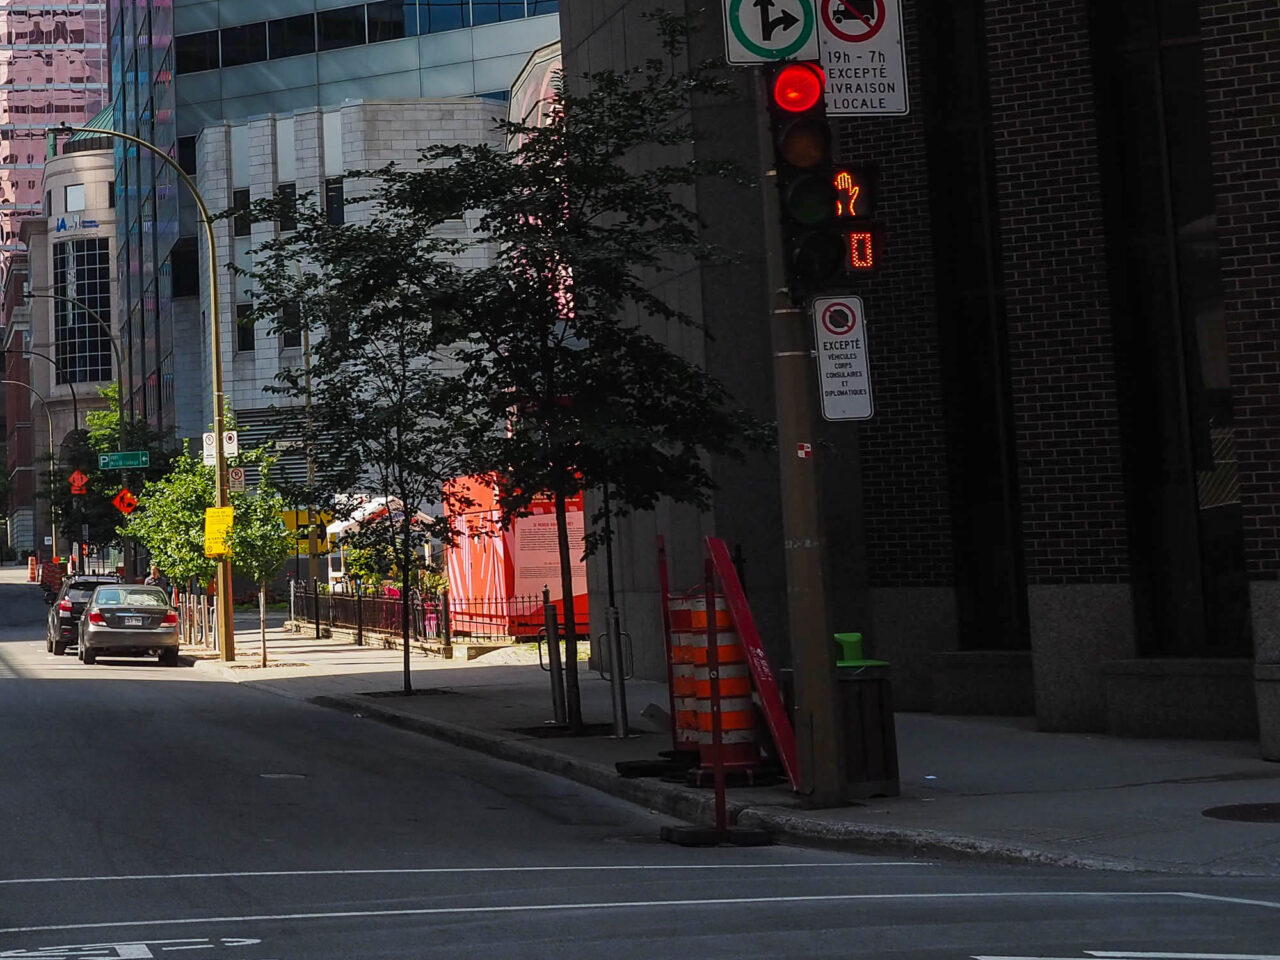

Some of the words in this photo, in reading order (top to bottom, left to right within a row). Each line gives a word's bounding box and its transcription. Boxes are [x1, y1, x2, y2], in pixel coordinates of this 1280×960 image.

[828, 51, 850, 63] 19h
[869, 50, 886, 63] 7h
[829, 64, 887, 79] EXCEPTÉ
[824, 82, 895, 94] IVRAISON
[834, 98, 887, 109] LOCALE
[851, 232, 872, 268] 0
[823, 339, 861, 351] EXCEPTÉ
[828, 353, 857, 361] VÉHICULES
[826, 371, 862, 379] CONSULAIRES
[824, 389, 867, 397] DIPLOMATIQUES
